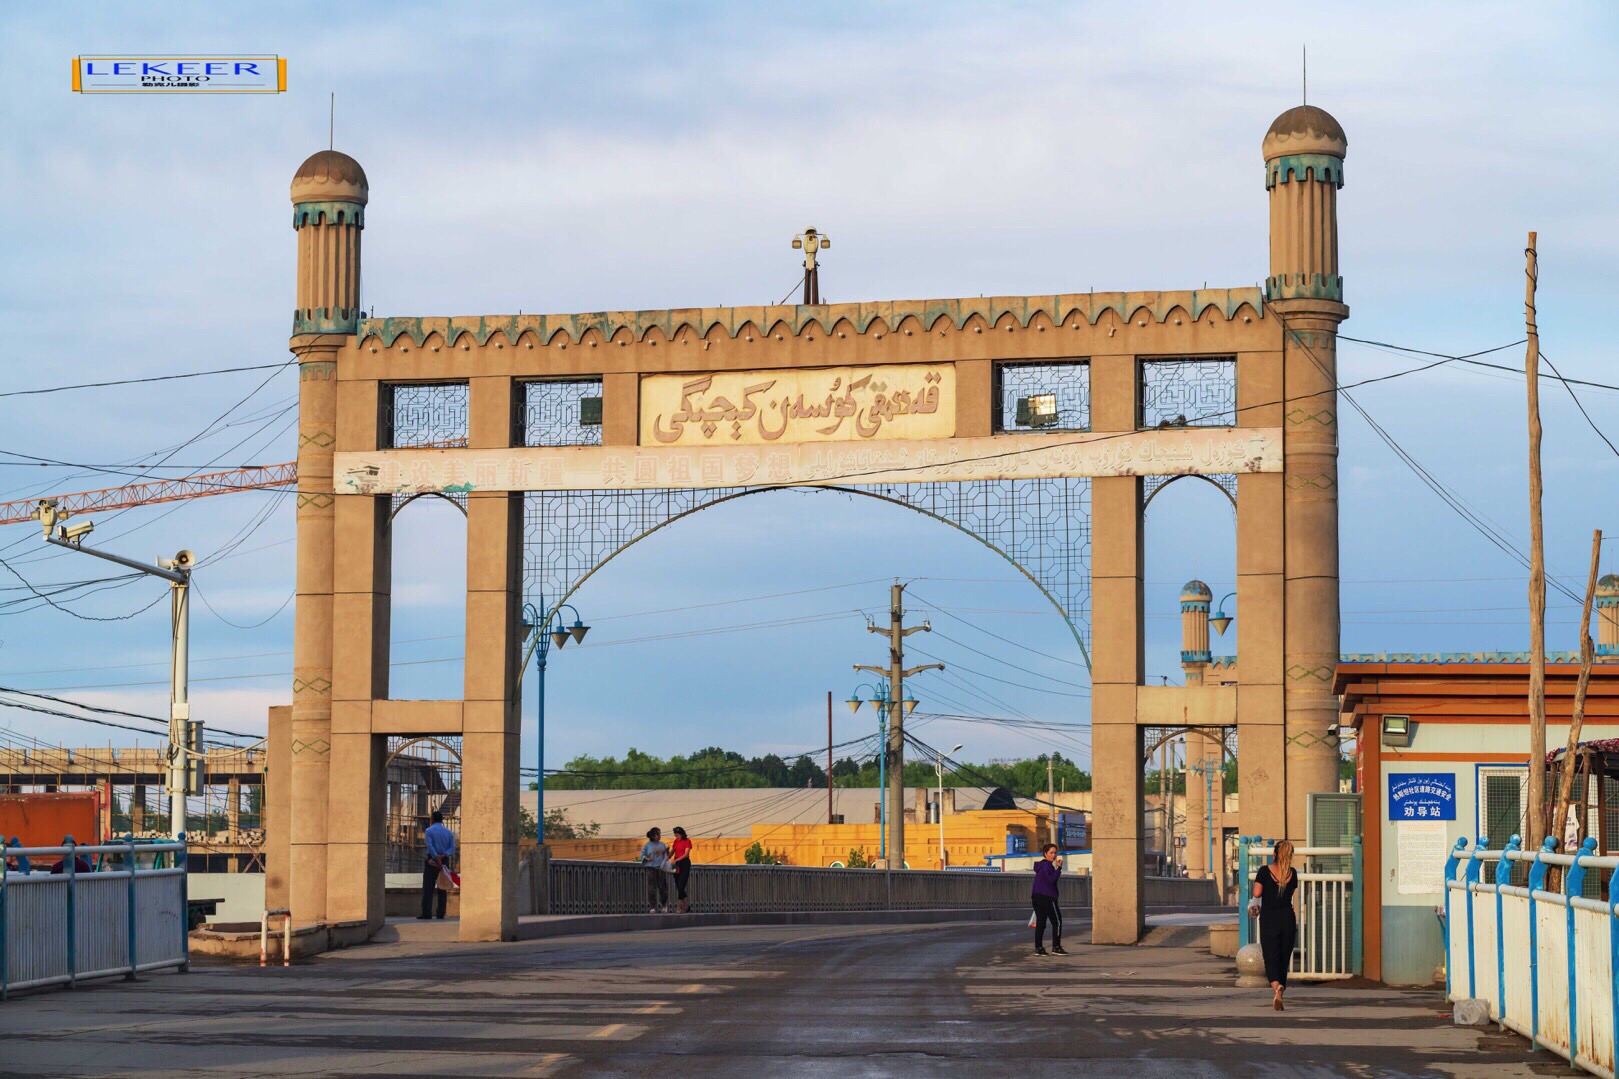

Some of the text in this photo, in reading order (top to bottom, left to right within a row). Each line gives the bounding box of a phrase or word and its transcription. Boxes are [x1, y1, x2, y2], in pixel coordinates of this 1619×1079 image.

[378, 451, 794, 486] 建设美丽新疆 共圆祖国梦想
[1404, 806, 1440, 817] 劝导站
